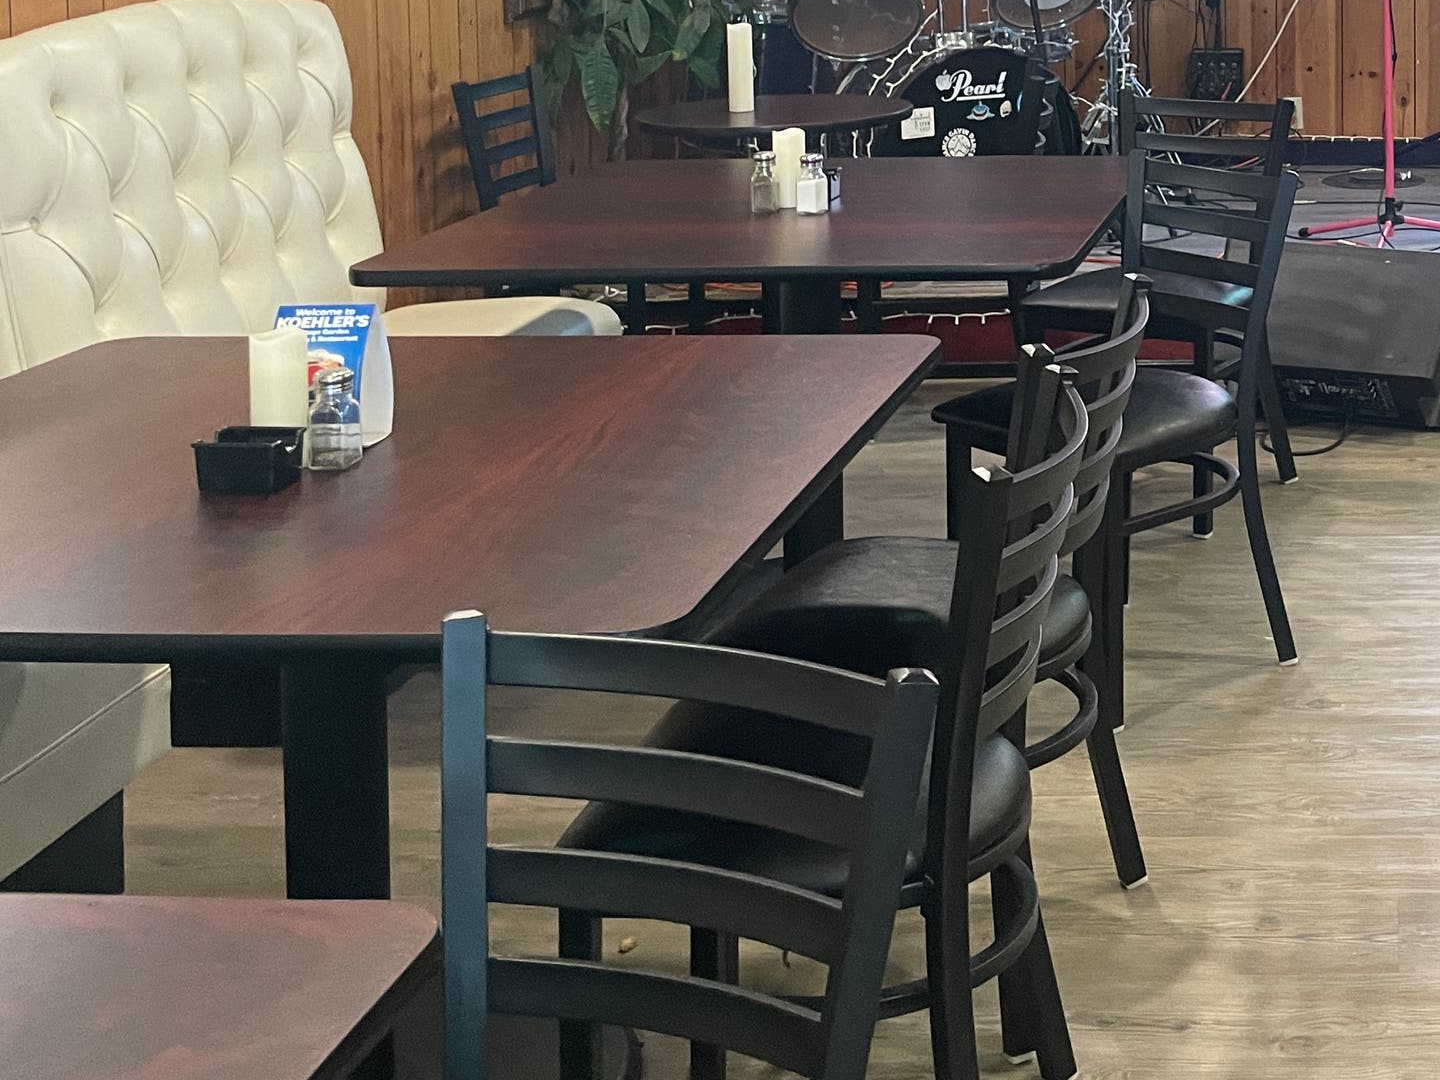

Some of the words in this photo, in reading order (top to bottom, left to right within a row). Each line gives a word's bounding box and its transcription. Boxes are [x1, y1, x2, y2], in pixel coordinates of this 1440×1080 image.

[941, 69, 1007, 102] Pearl
[296, 308, 343, 316] Welcome
[345, 307, 356, 315] to
[276, 315, 370, 329] KOEHLER'S
